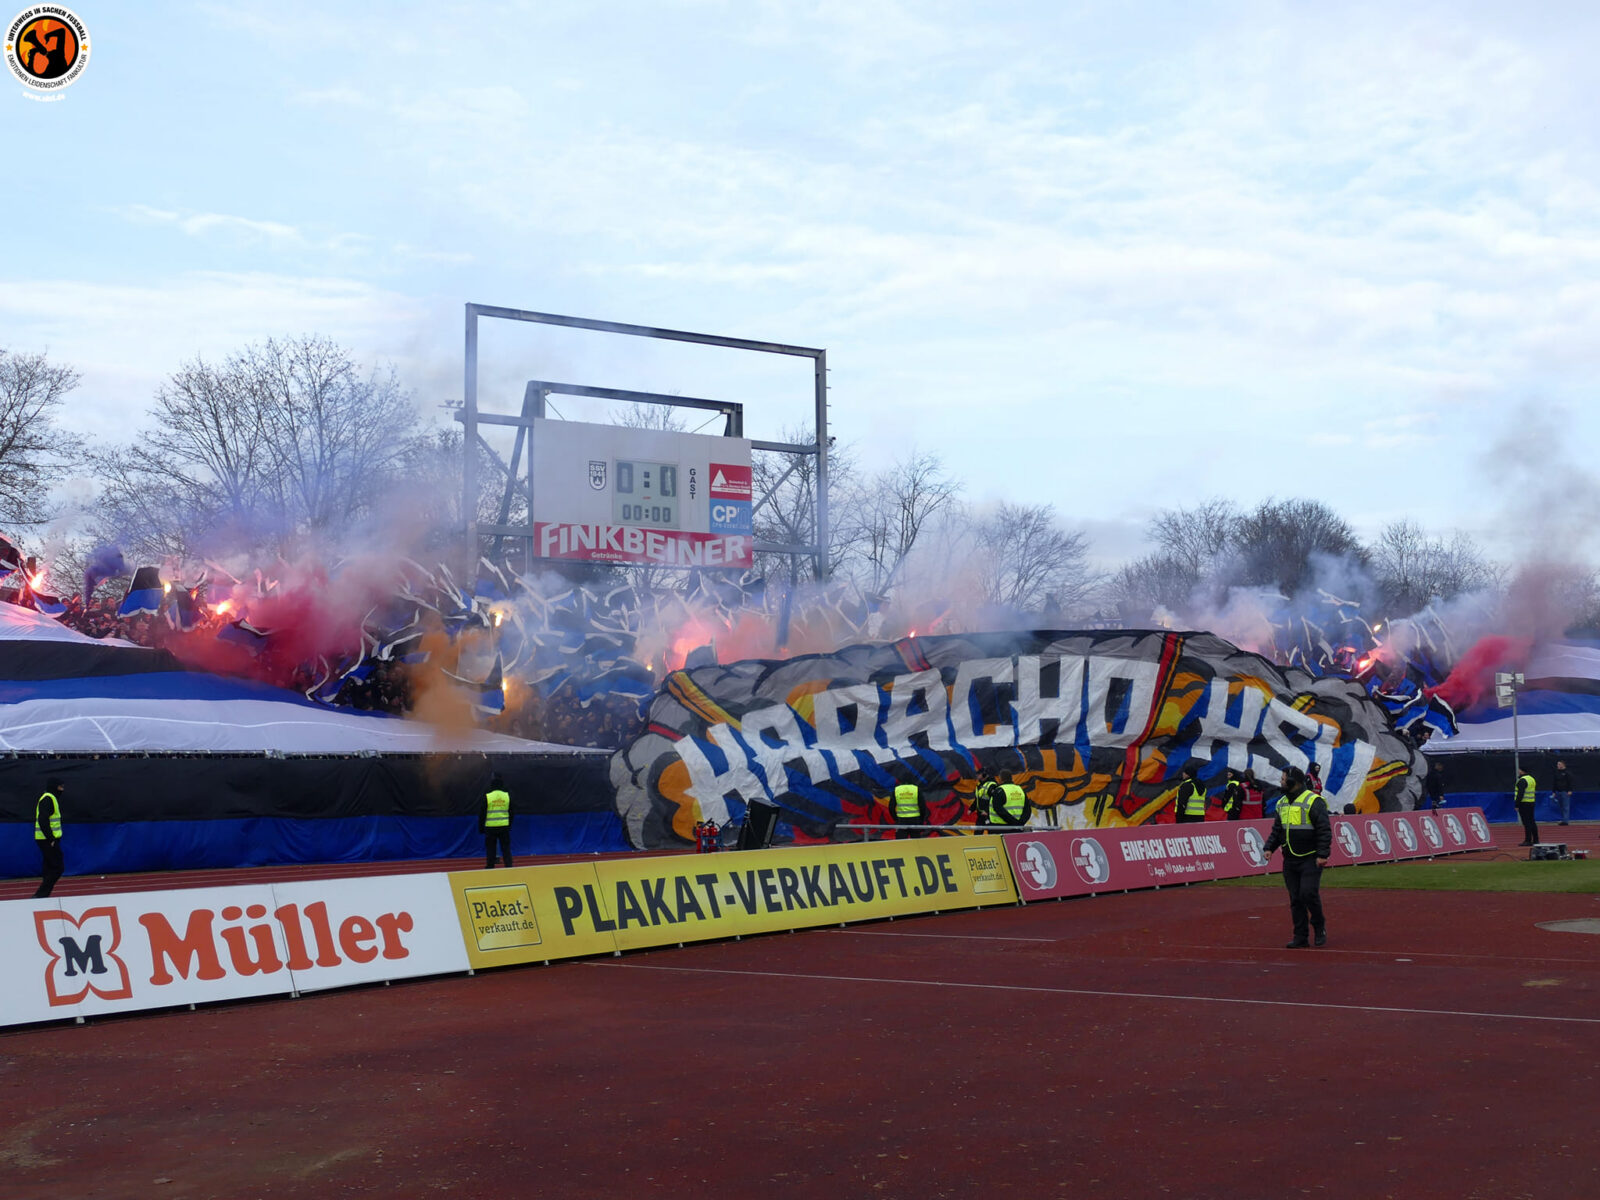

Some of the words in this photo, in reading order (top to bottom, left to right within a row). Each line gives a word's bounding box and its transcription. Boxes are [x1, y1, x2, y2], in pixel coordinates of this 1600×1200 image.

[689, 468, 697, 500] GAST
[623, 504, 671, 523] 00:00
[540, 522, 746, 568] FINKBEINER
[591, 551, 623, 561] Getränke
[1080, 842, 1100, 879] 3
[1120, 838, 1167, 862] EINFACH
[1165, 837, 1193, 858] GUTE
[1190, 834, 1227, 855] MUSIK.
[1244, 831, 1261, 862] 3
[968, 857, 999, 871] Plakat-
[1026, 847, 1047, 884] 3
[472, 900, 529, 919] Plakat-
[553, 853, 959, 936] PLAKAT-VERKAUFT.DE
[138, 900, 414, 986] Müller
[478, 920, 534, 935] verkauft.de
